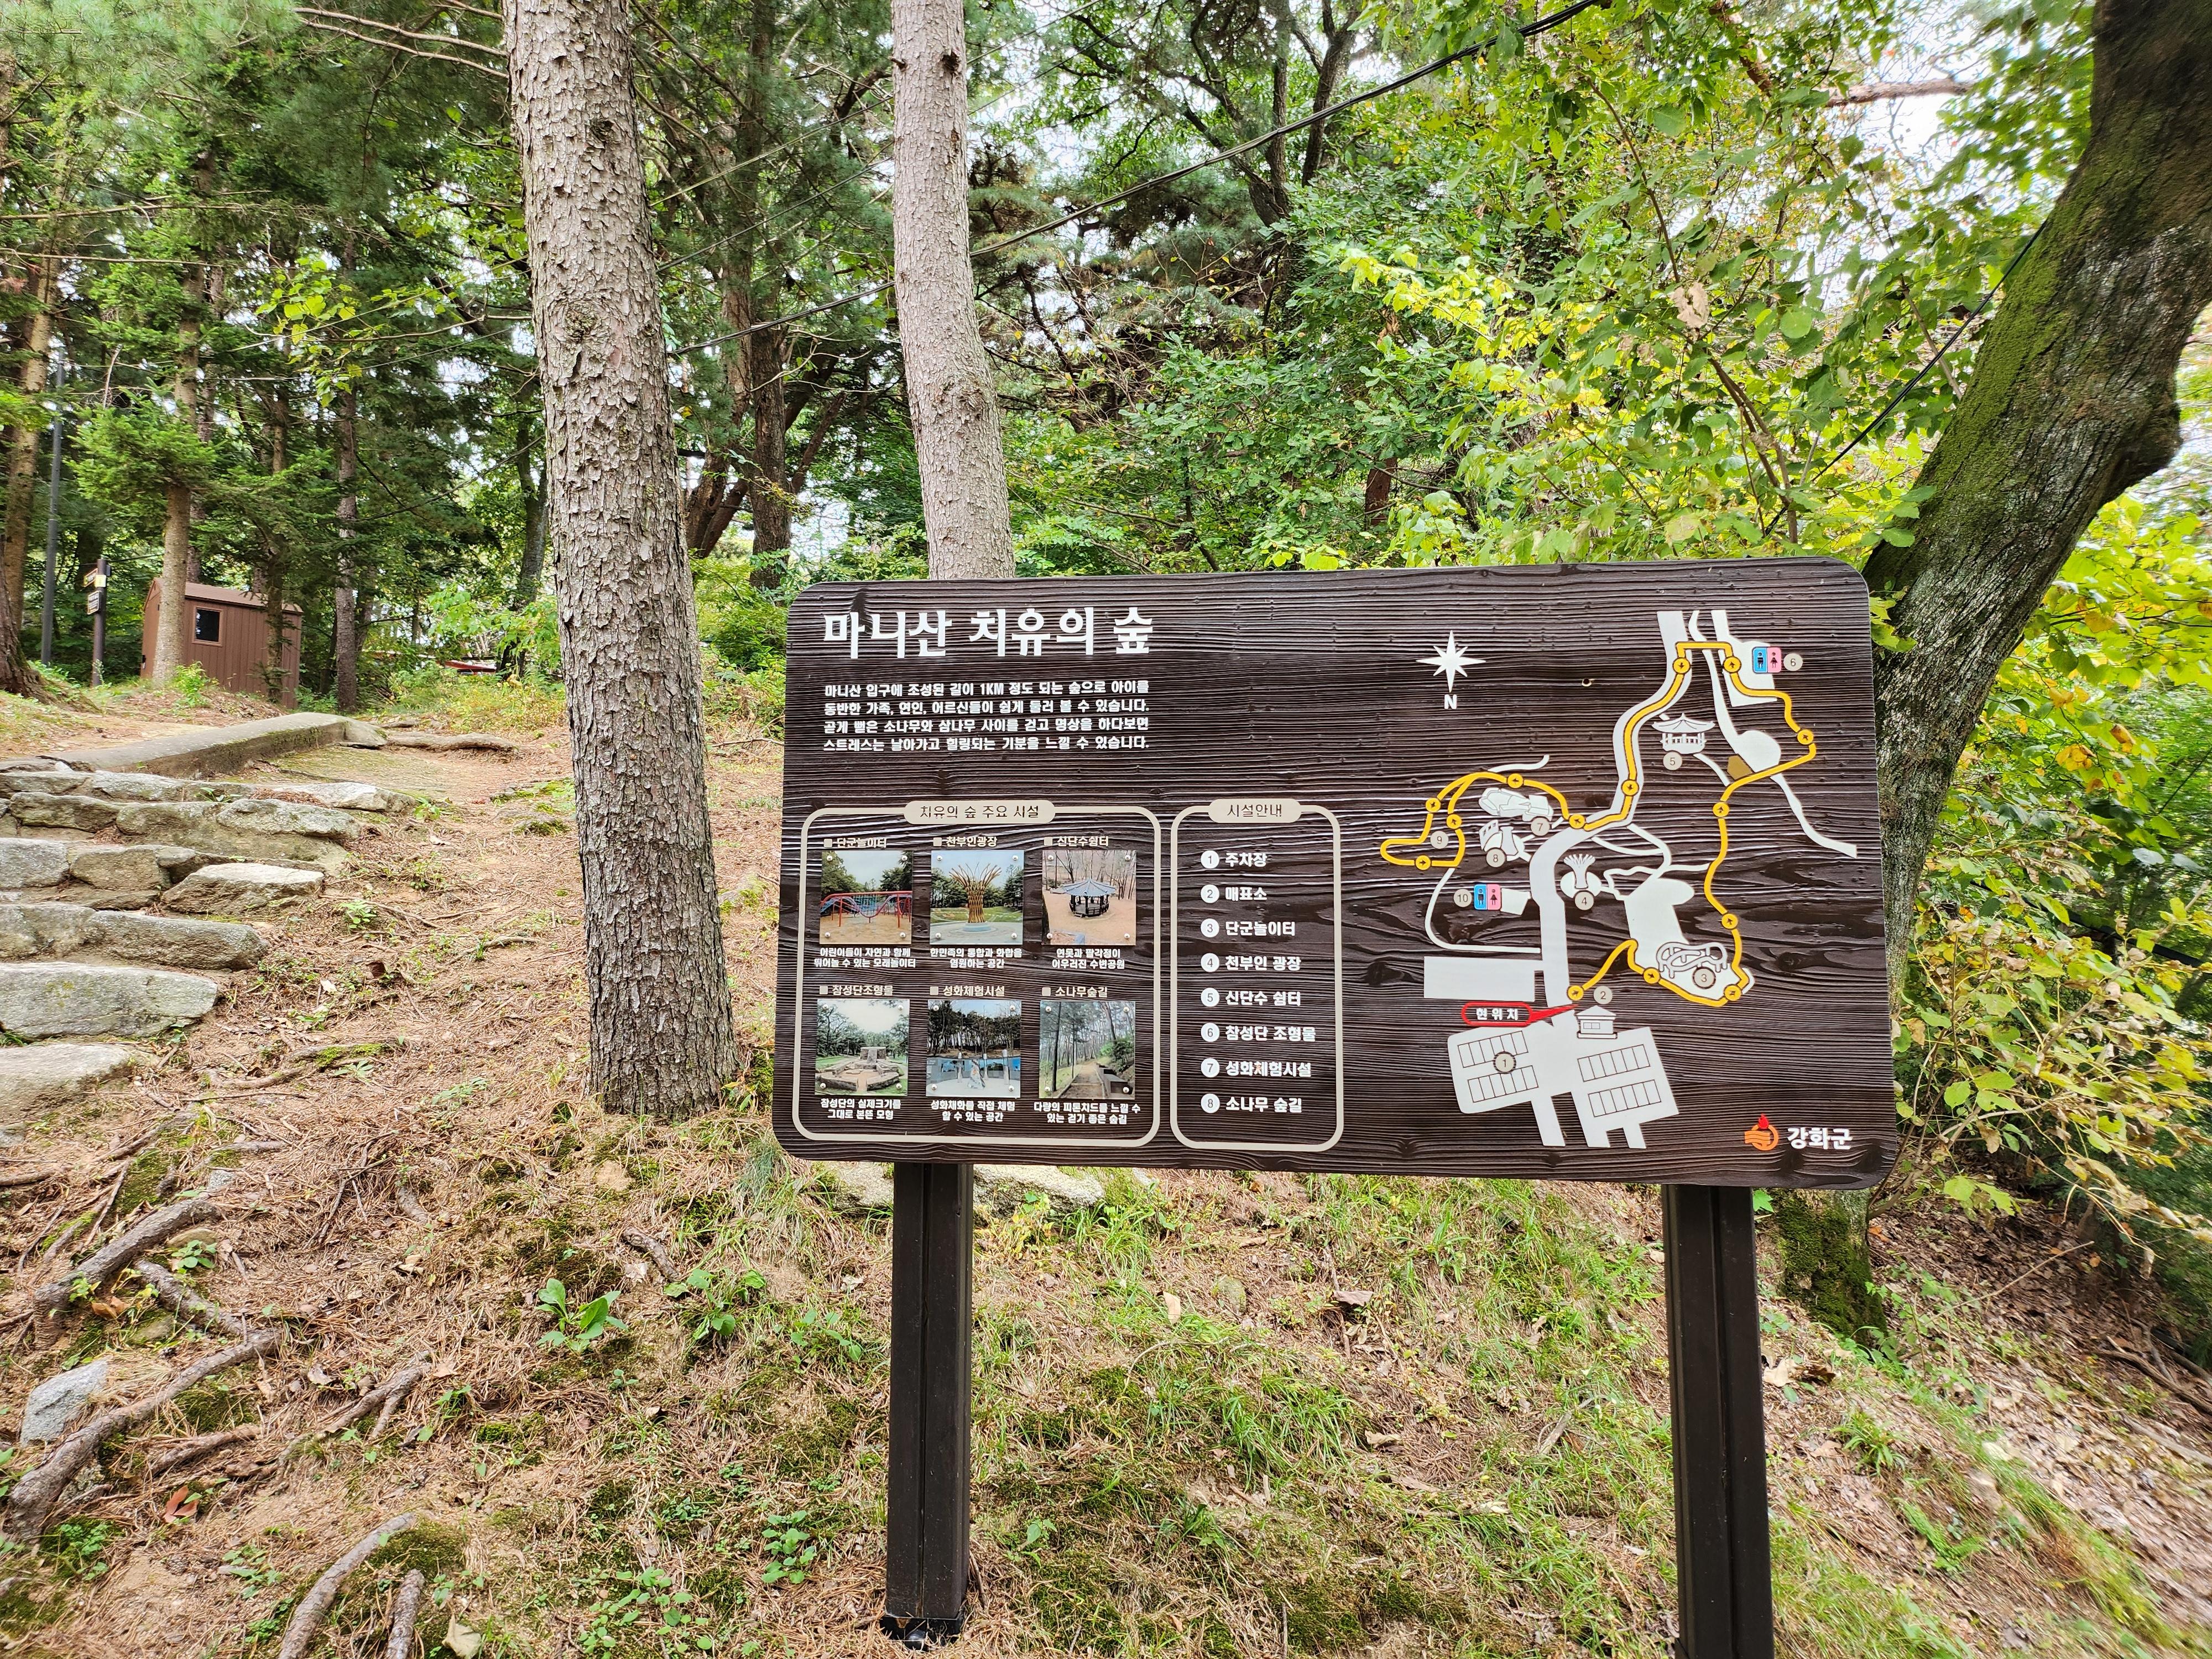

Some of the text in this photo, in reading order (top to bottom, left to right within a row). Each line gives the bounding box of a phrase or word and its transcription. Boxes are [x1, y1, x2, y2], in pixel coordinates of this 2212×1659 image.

[823, 607, 1154, 659] 마니산 치유의 숲
[825, 680, 1149, 697] 마니산 입구에 조성된 길이 1KM 정도 되는 숲으로 아이를
[824, 699, 1149, 716] 동반한 가족, 연인, 어르신들이 쉽게 둘러 볼 수 있습니다.
[1444, 694, 1457, 709] N
[824, 717, 1149, 734] 곧게 뻗은 소나무와 삼나무 사이를 걷고 명상을 하다보면
[823, 736, 1149, 752] 스트레스는 날아가고 힐링되는 기분을 느낄 수 있습니다.
[920, 805, 1039, 818] 치유의 숲 주요 시설
[1227, 804, 1282, 817] 시설안내
[837, 837, 887, 848] 단군놀이터
[946, 836, 997, 848] 천부인광장
[1057, 836, 1109, 847] 신단수쉼터
[1225, 852, 1267, 867] 주차장
[1225, 886, 1267, 901] 매표소
[1457, 894, 1469, 903] 10
[1225, 921, 1296, 936] 단군놀이터
[820, 947, 911, 957] 어린이들이 자연과 함께
[930, 948, 964, 958] 한민족의
[996, 948, 1022, 958] 화합을
[1056, 948, 1120, 958] 연못과 팔각정이
[842, 958, 851, 968] 수
[853, 958, 870, 968] 있는
[873, 958, 916, 968] 모래놀이터
[987, 958, 1005, 968] 공간
[1052, 959, 1125, 969] 어우러진 수변공원
[1225, 955, 1267, 971] 천부인
[1272, 956, 1302, 972] 광장
[832, 985, 893, 996] 참성단조형물
[943, 985, 1005, 997] 성화체험시설
[1055, 986, 1108, 998] 소나무숲길
[1225, 990, 1268, 1006] 신단수
[1272, 991, 1301, 1006] 쉼터
[1225, 1025, 1269, 1041] 참성단
[1273, 1026, 1316, 1042] 조형물
[1225, 1061, 1312, 1078] 성화체험시설
[821, 1098, 901, 1109] 참성단의 실제크기를
[977, 1100, 994, 1111] 직접
[998, 1101, 1015, 1112] 체험
[1034, 1102, 1060, 1112] 다량의
[1063, 1102, 1108, 1113] 피톤치드를
[1131, 1103, 1141, 1114] 수
[1225, 1096, 1269, 1113] 소나무
[1274, 1097, 1302, 1113] 숲길
[827, 1109, 894, 1120] 그대로 본뜬 모형
[942, 1111, 1004, 1122] 할 수 있는 공간
[1047, 1113, 1127, 1124] 있는 걷기 좋은 숲길
[1787, 1127, 1853, 1150] 강화군
